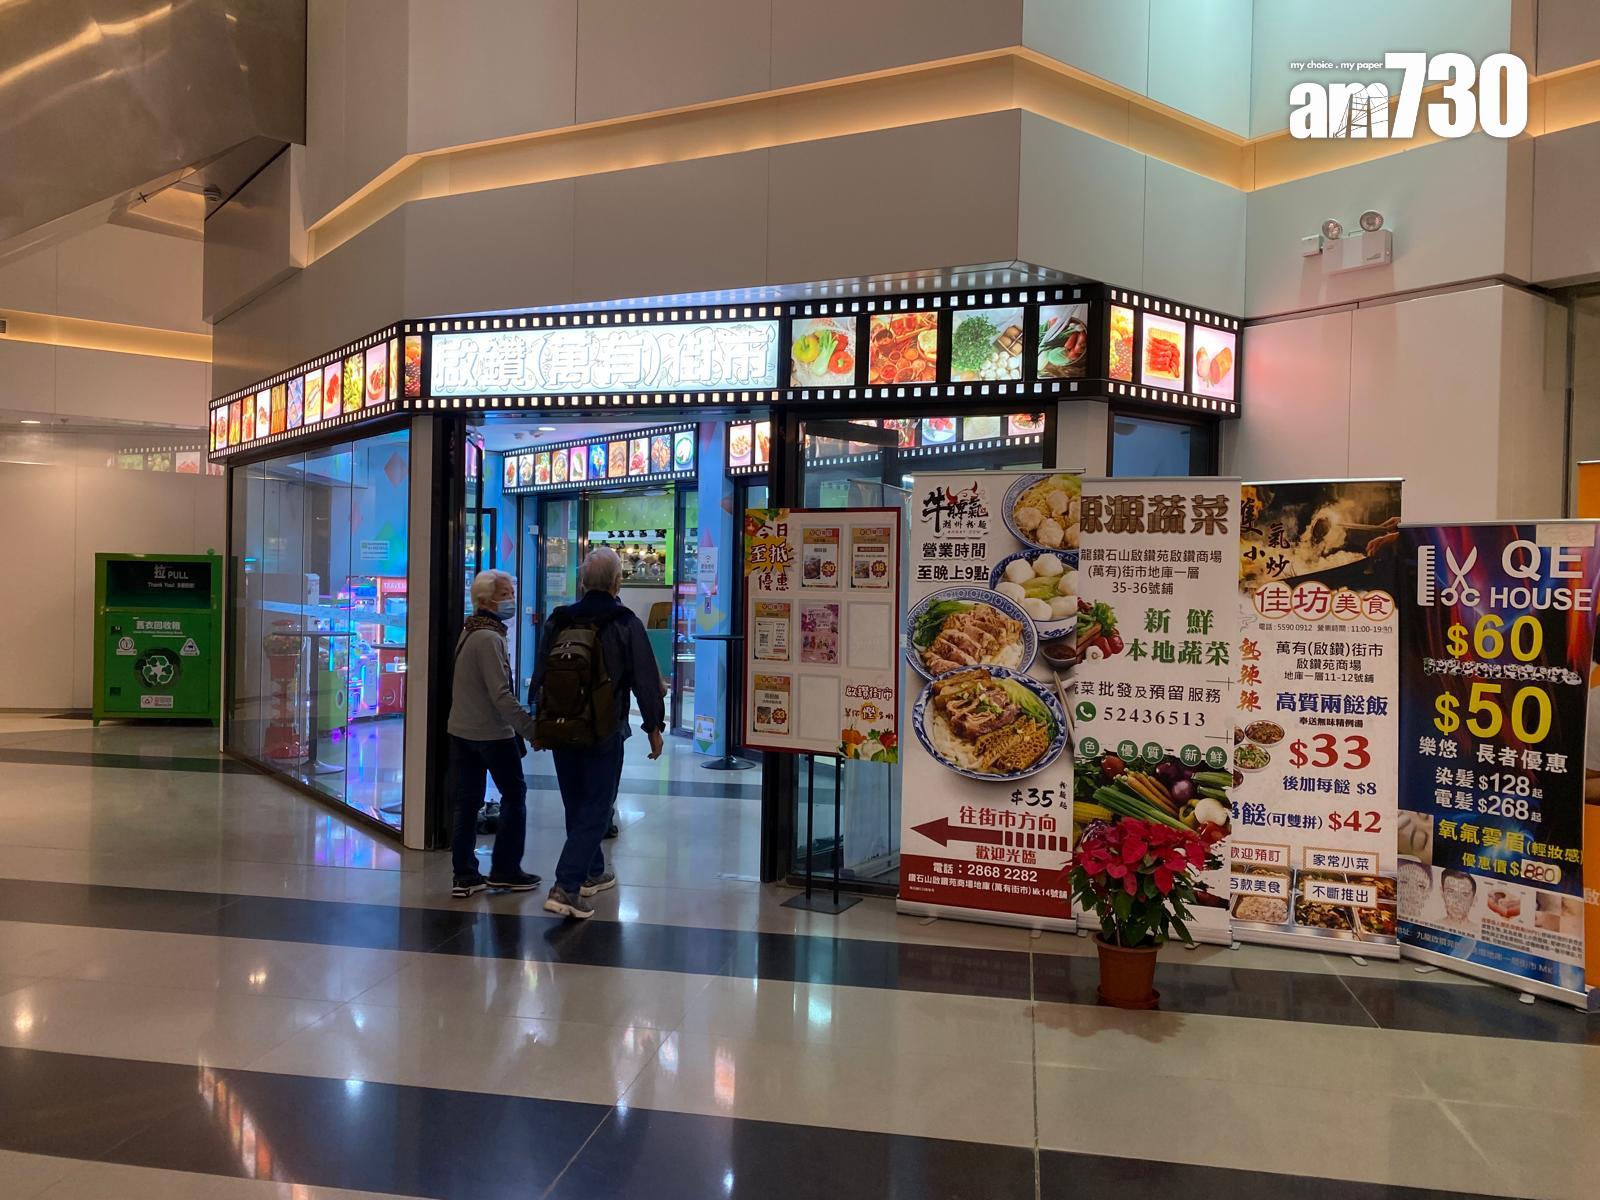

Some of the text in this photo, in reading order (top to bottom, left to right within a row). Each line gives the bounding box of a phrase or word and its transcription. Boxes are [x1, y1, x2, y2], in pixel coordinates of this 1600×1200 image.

[757, 523, 788, 539] 今日
[750, 543, 789, 564] 至抵
[922, 541, 986, 560] 營業時間
[1243, 545, 1290, 578] 小炒
[1501, 539, 1583, 582] QE
[167, 570, 189, 580] PULL
[758, 573, 790, 592] 優惠
[917, 564, 990, 582] 至晚上9點
[1087, 563, 1200, 581] (萬有)街市地庫一層
[1255, 586, 1391, 616] 佳坊美食
[1489, 586, 1593, 612] HOUSE
[1277, 623, 1295, 632] 5590
[1295, 624, 1313, 632] 0912
[1445, 613, 1543, 662] $60
[1124, 637, 1231, 667] 本地蔬菜
[1275, 640, 1384, 658] 萬有(啟鑽)街市
[1296, 657, 1362, 672] 啟鑽苑商場
[1275, 692, 1388, 716] 高質兩餸飯
[1433, 682, 1552, 744] $50
[1103, 705, 1206, 728] 52436513
[1120, 743, 1161, 761] 優質
[1184, 748, 1223, 765] 新鮮
[1288, 733, 1371, 770] $33
[1418, 735, 1569, 774] 樂悠 長者優惠
[1282, 775, 1377, 796] 後加每餸 $8
[1435, 766, 1544, 800] 染髮 $128 起
[1010, 786, 1055, 809] $35
[1434, 788, 1543, 824] 電髮 $268 起
[958, 805, 1057, 833] 往街市方向
[1327, 810, 1382, 834] $42
[975, 845, 1037, 865] 歡迎光臨
[1312, 853, 1370, 871] 家常小菜
[1462, 852, 1507, 875] 優惠價
[966, 862, 1001, 880] 2868
[1003, 867, 1038, 884] 2282
[1312, 885, 1369, 904] 不斷推出
